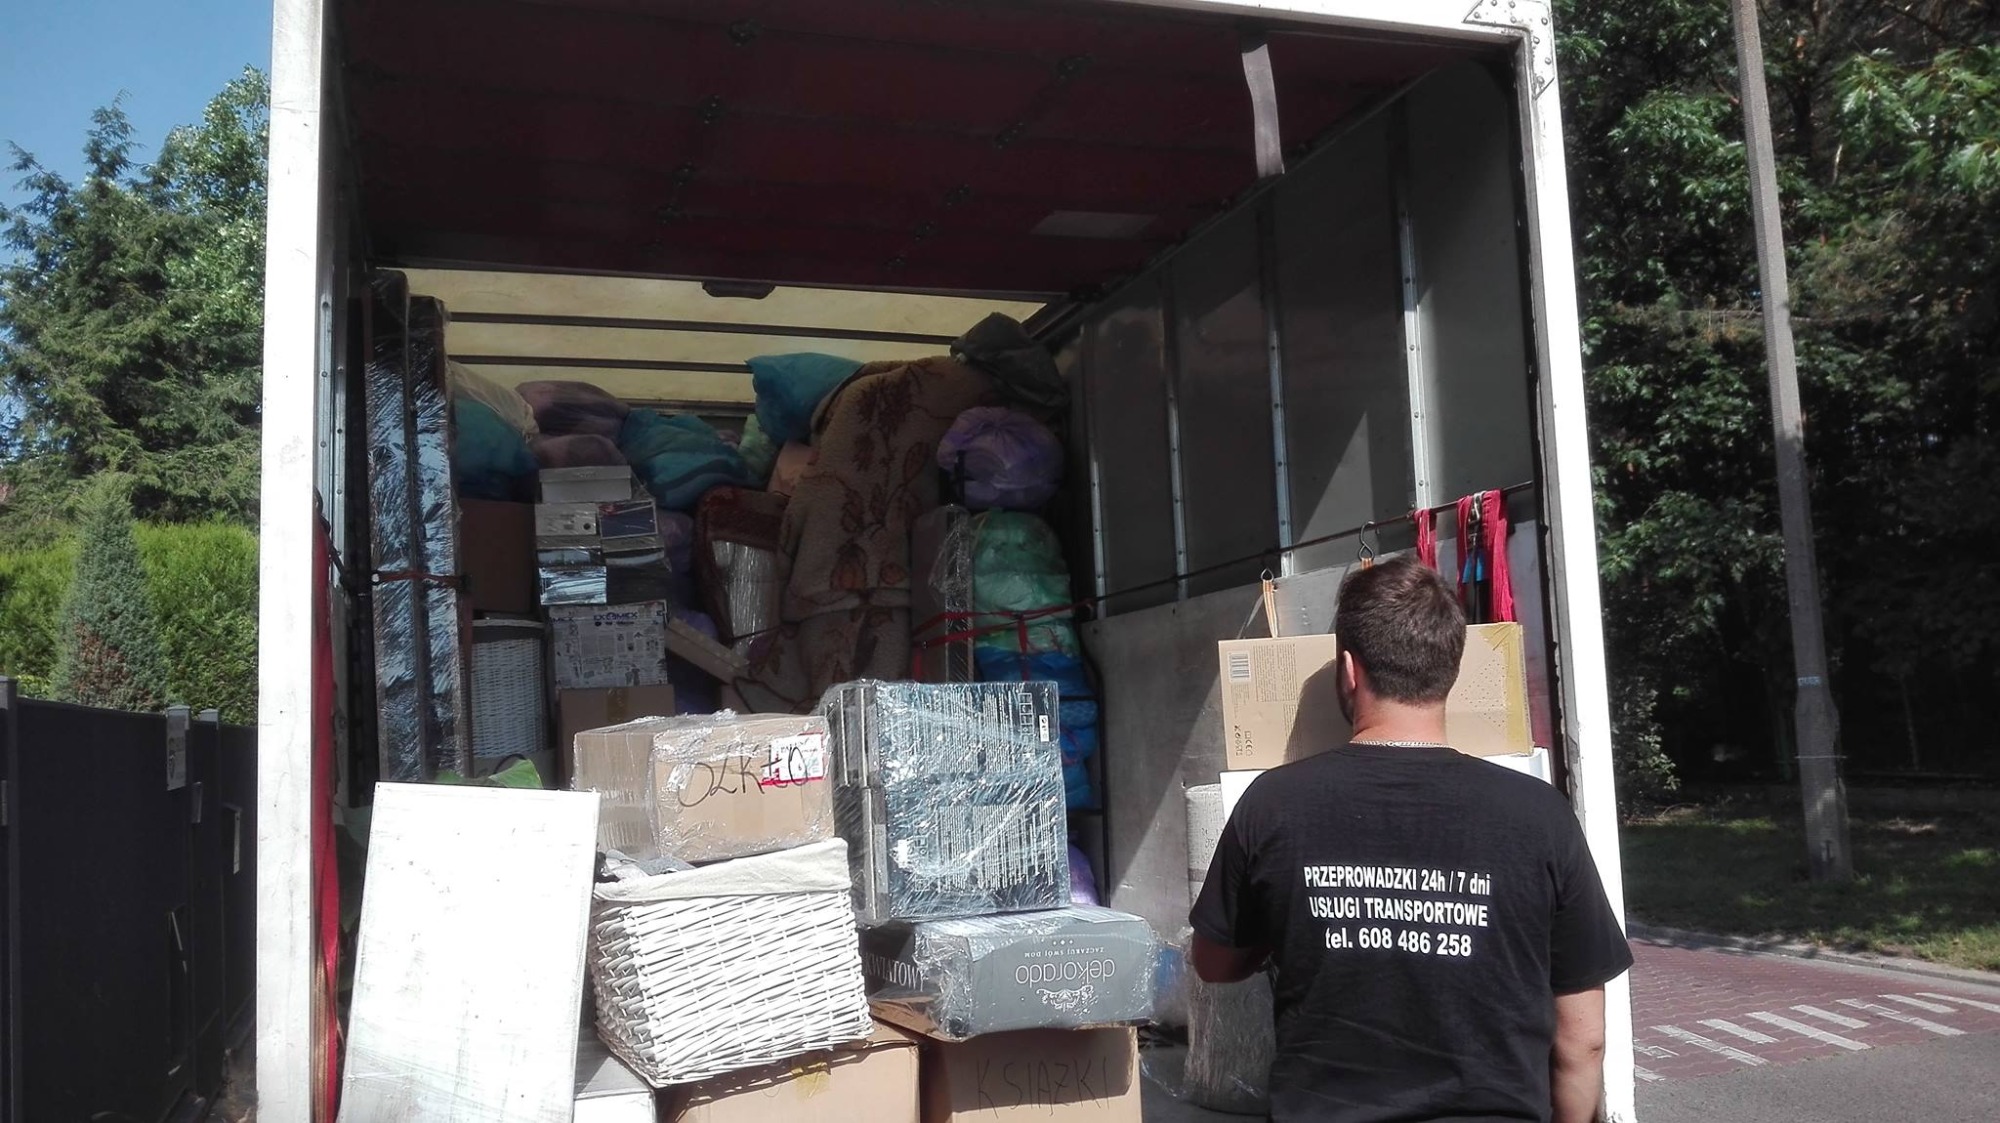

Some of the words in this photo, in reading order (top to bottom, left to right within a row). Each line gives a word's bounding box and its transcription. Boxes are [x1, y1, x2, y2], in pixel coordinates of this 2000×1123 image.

[1304, 865, 1417, 891] PRZEPROWADZKI
[1421, 869, 1446, 892] 24h
[1449, 870, 1454, 893] /
[1457, 871, 1466, 893] 7
[1469, 872, 1491, 896] dni
[1309, 896, 1360, 919] USŁUGI
[1364, 897, 1488, 927] TRANSPORTOWE
[1325, 927, 1353, 949] tel.
[1358, 927, 1393, 949] 608
[1397, 930, 1431, 954] 486
[1436, 933, 1472, 957] 258
[1015, 958, 1115, 988] dekorado
